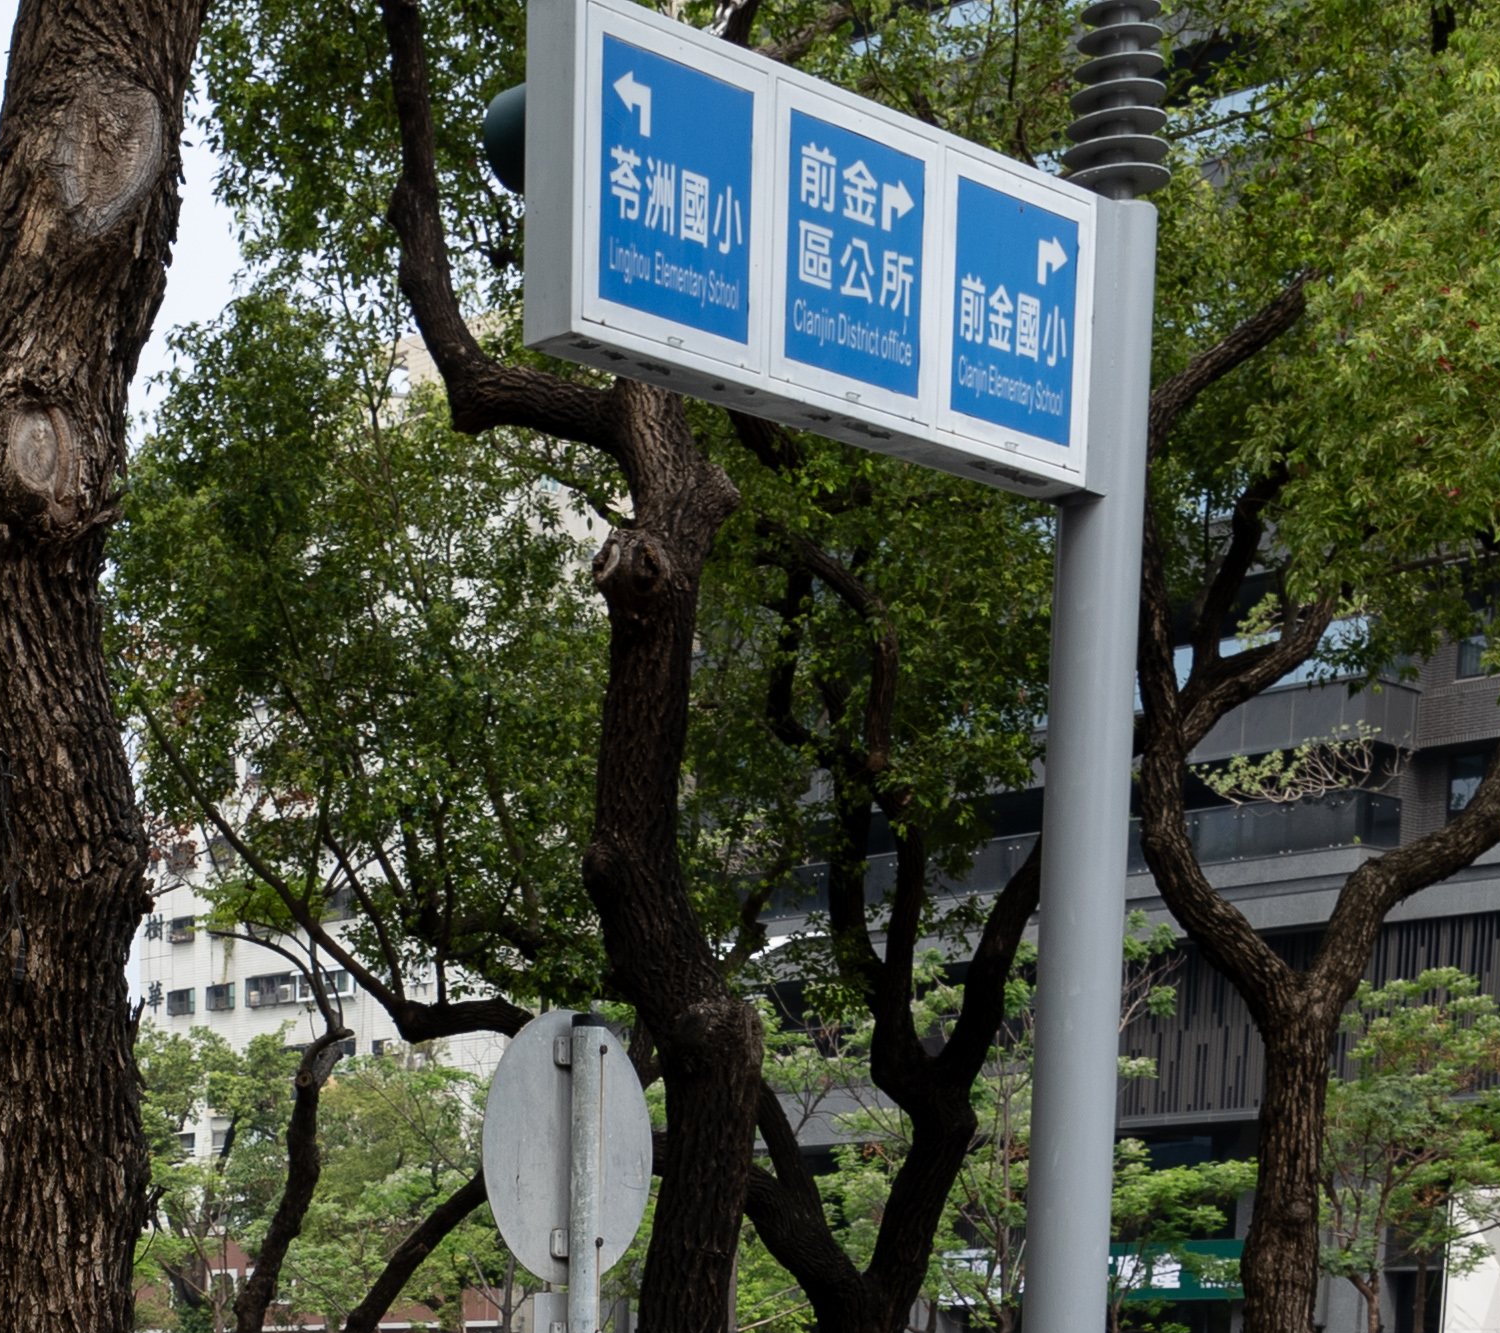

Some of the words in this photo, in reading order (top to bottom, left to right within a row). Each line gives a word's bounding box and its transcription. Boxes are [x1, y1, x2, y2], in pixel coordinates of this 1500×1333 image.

[609, 144, 743, 254] 苓洲國小
[801, 142, 878, 226] 前金
[655, 251, 707, 308] Elementary
[708, 269, 740, 310] School
[798, 219, 914, 317] 區公所
[793, 299, 835, 346] Cianjin
[838, 313, 879, 357] District
[881, 329, 912, 366] office
[959, 273, 1067, 367] 前金國小
[958, 355, 987, 398] Cianjin
[988, 364, 1035, 415] Elementary
[1036, 380, 1064, 416] School
